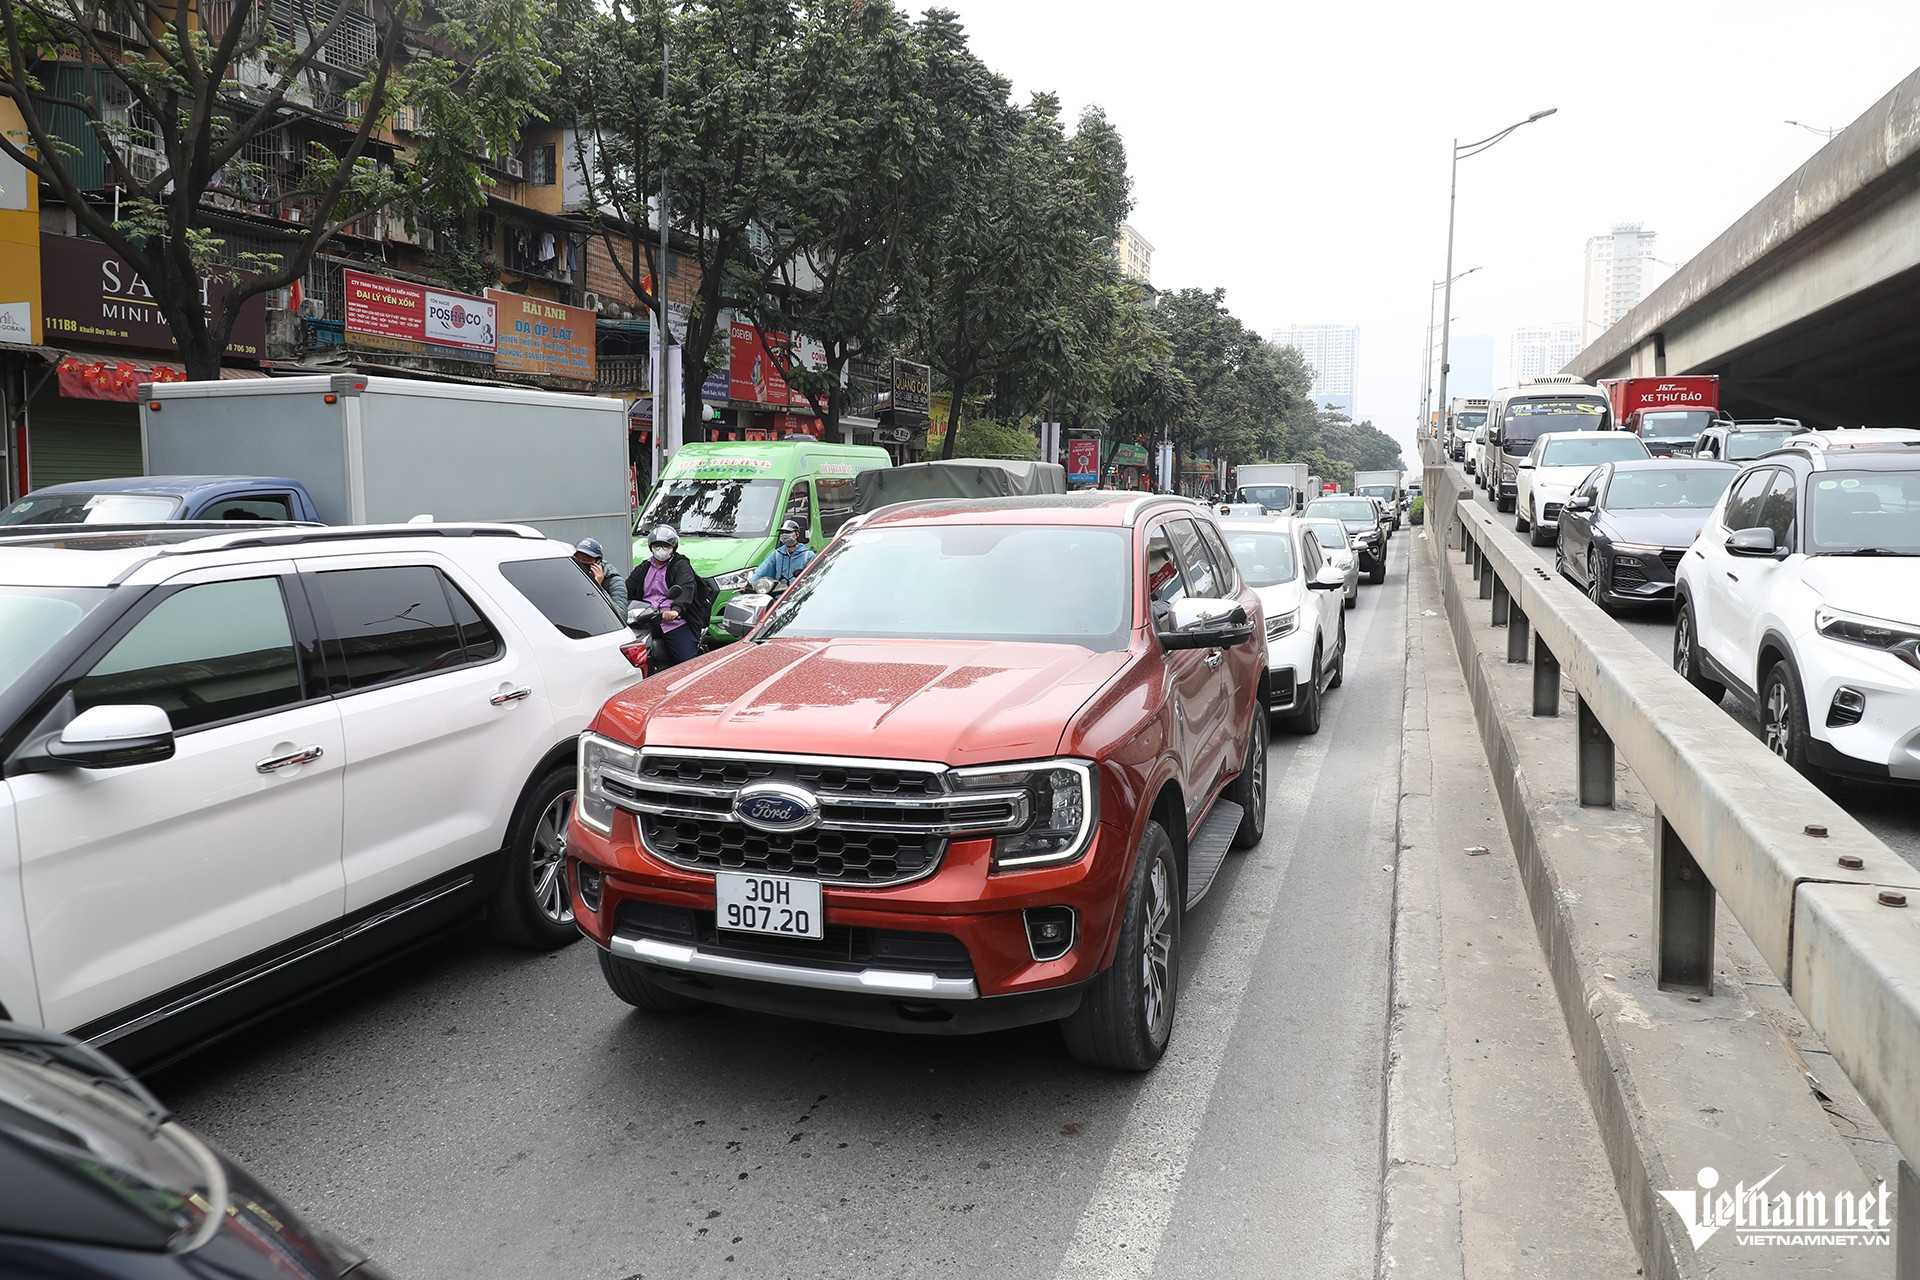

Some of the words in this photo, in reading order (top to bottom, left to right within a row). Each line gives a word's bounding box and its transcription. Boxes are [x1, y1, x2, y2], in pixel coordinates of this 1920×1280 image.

[102, 259, 211, 307] SAH
[356, 290, 371, 301] ĐẠI
[372, 292, 381, 302] LÝ
[382, 295, 397, 305] YÊN
[102, 303, 149, 323] MINI
[429, 306, 481, 326] POSHACO
[522, 301, 542, 316] HẢI
[544, 306, 567, 320] ANH
[45, 317, 77, 332] 111B8
[534, 320, 549, 337] ỐP
[552, 327, 574, 341] LÁT
[731, 327, 753, 341] OSEVEN
[232, 344, 245, 353] 706
[245, 346, 257, 354] 309
[1641, 394, 1654, 402] XE
[1656, 392, 1680, 401] THƯ
[1680, 391, 1702, 401] BÁO
[751, 799, 793, 819] Ford
[745, 878, 790, 905] 30H
[727, 903, 809, 934] 907.20
